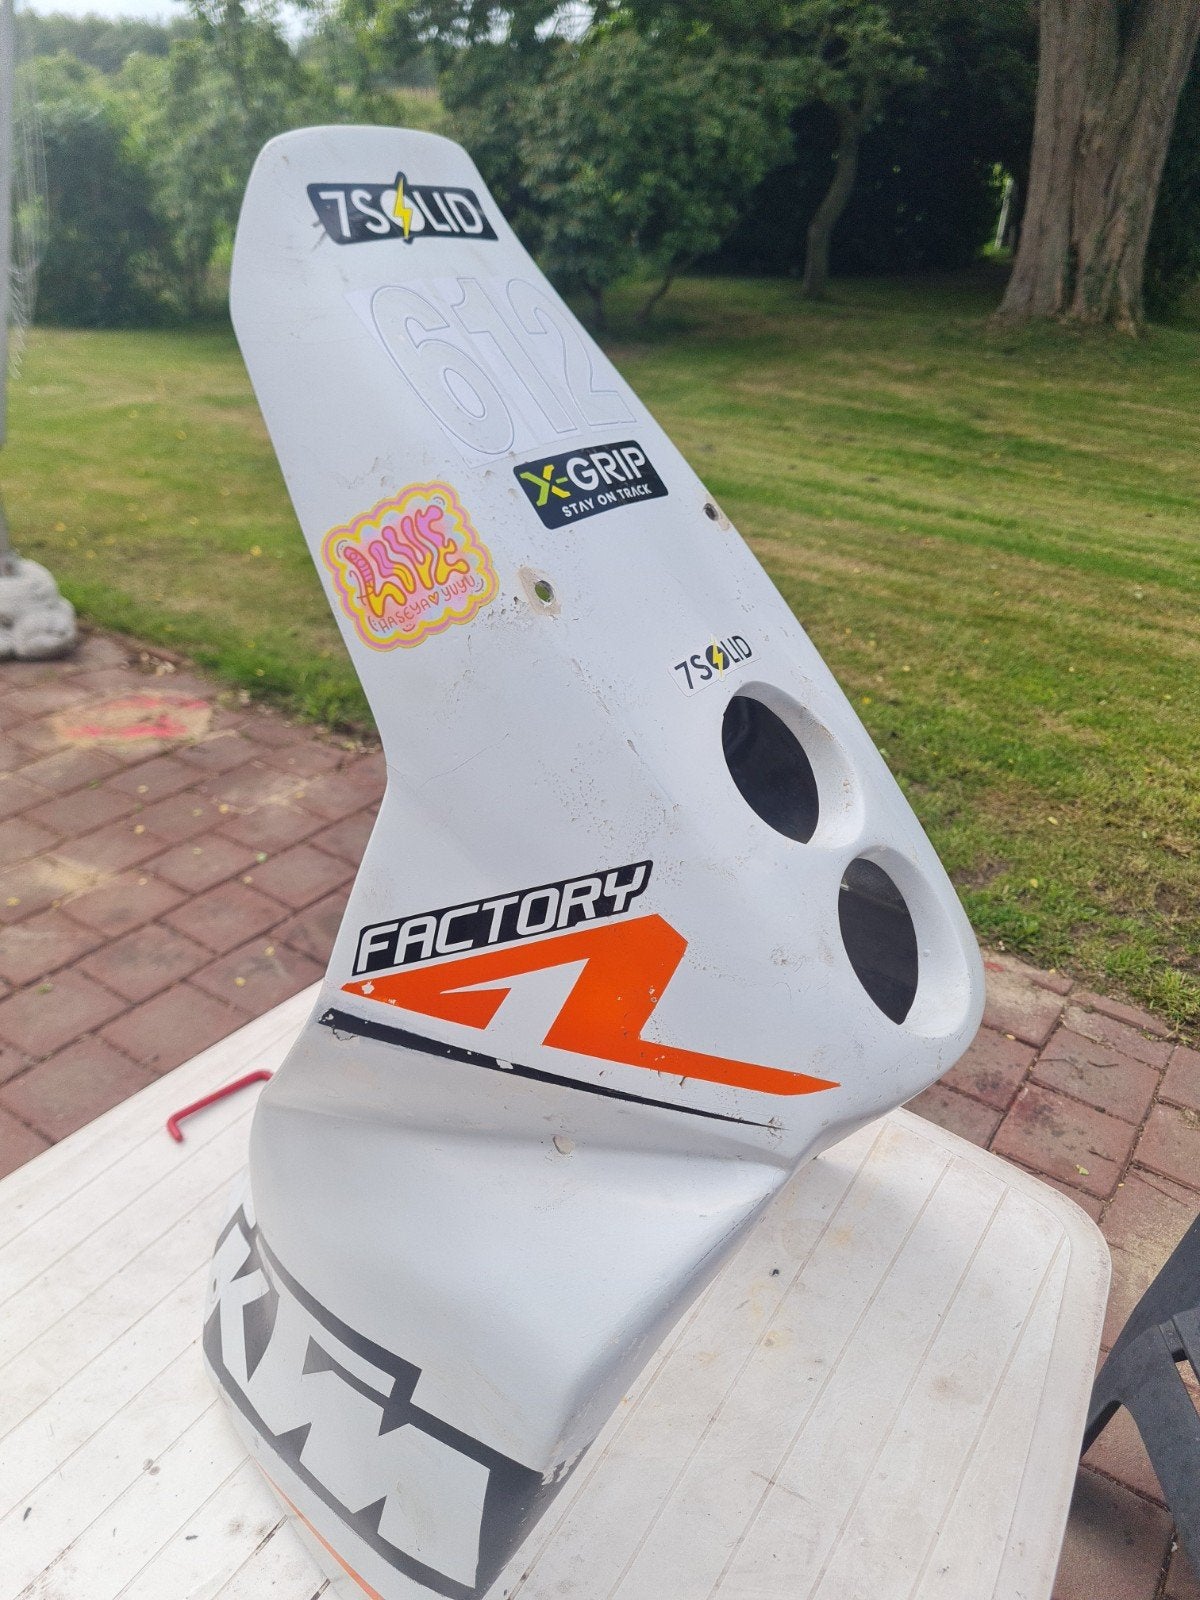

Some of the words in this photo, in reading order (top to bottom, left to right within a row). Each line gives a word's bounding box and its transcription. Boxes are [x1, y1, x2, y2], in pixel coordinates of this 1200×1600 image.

[318, 188, 485, 238] 7SOLID
[370, 277, 638, 456] 612
[519, 446, 647, 507] X-GRIP
[561, 497, 595, 518] STAY
[597, 490, 617, 506] ON
[616, 483, 653, 500] TRACK
[673, 635, 753, 690] 7SOLID
[356, 864, 647, 974] FACTORY
[203, 1210, 491, 1590] KTM
